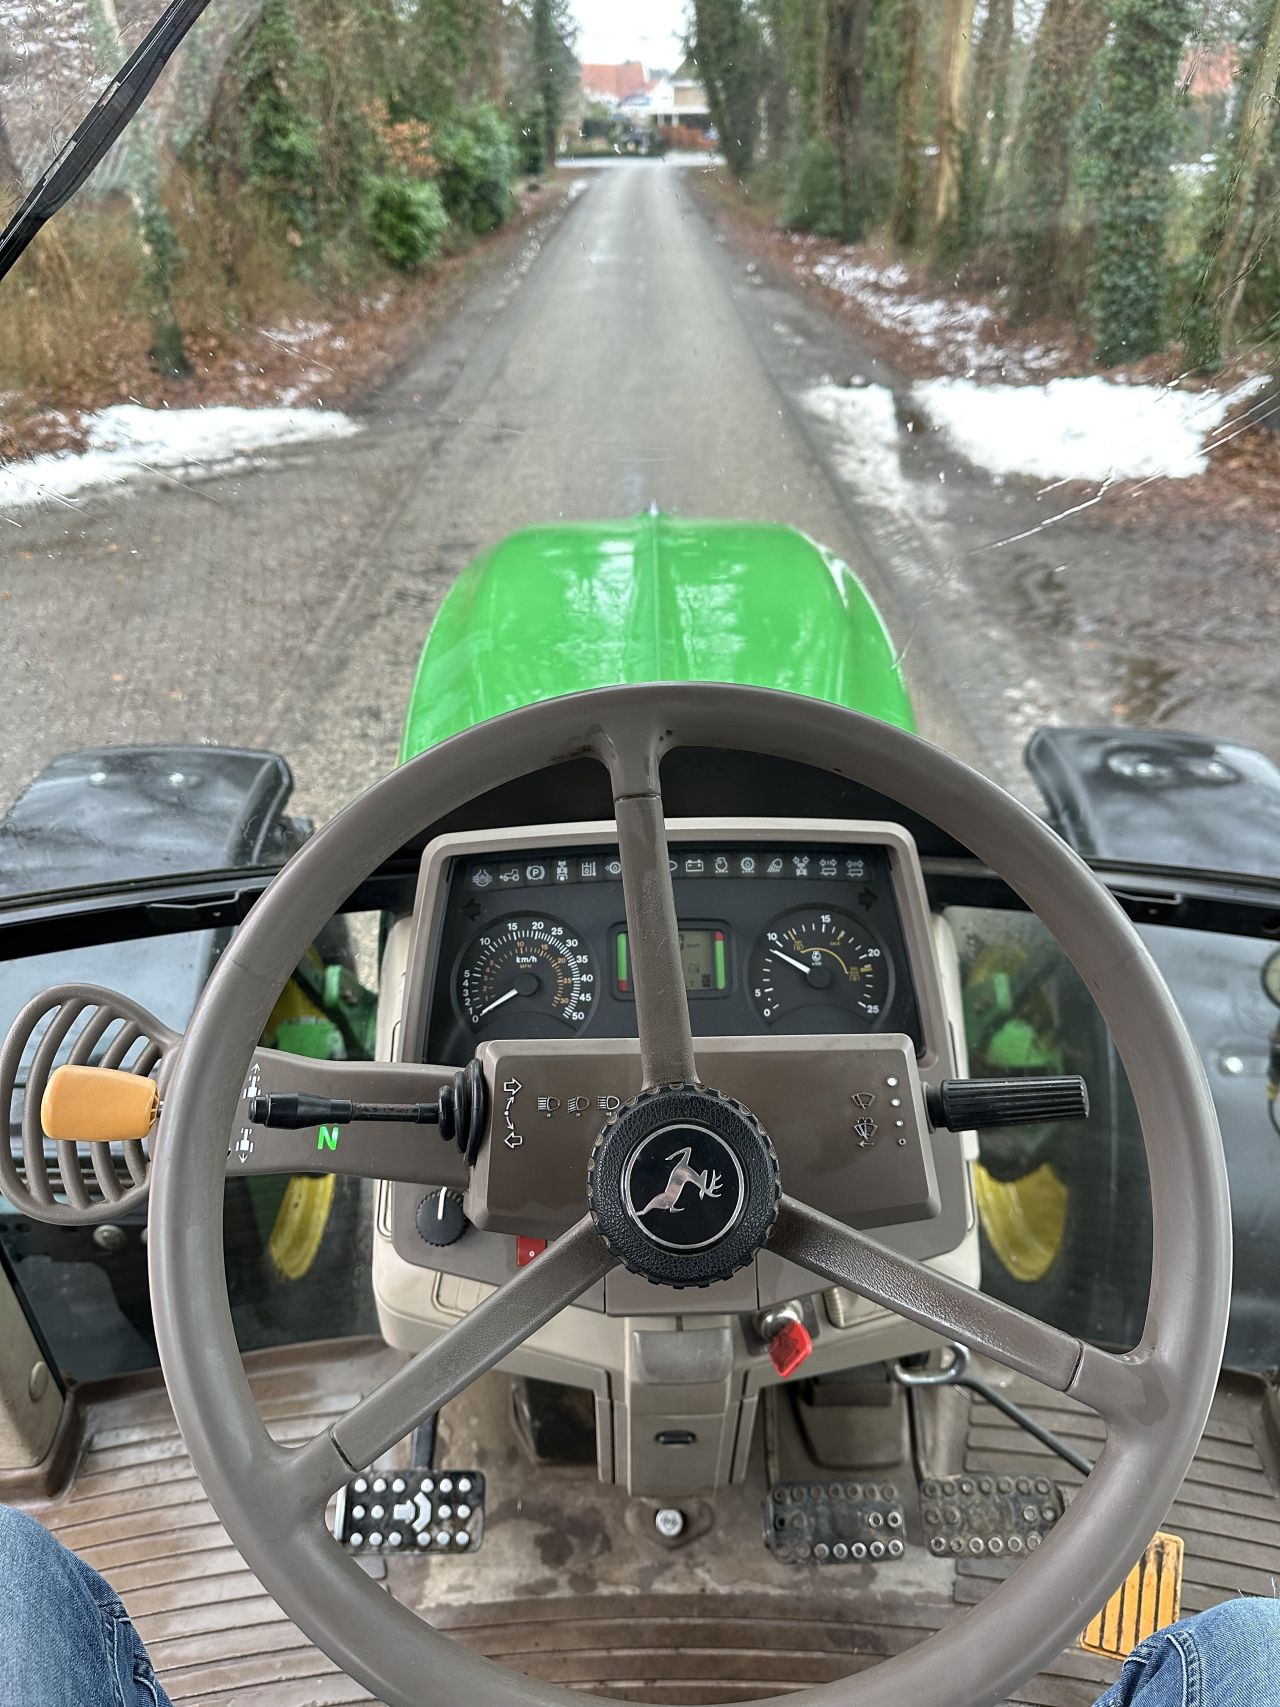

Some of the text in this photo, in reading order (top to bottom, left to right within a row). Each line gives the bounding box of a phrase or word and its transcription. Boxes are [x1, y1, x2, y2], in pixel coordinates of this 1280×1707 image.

[820, 914, 831, 923] 15
[507, 922, 518, 930] 15
[532, 922, 544, 930] 20
[551, 927, 563, 935] 25
[766, 933, 778, 941] 10
[480, 937, 491, 946] 10
[566, 939, 578, 947] 30
[868, 949, 881, 957] 20
[576, 955, 588, 964] 35
[581, 974, 593, 982] 40
[463, 989, 469, 997] 3
[579, 993, 592, 1001] 45
[755, 989, 761, 997] 5
[464, 998, 471, 1006] 2
[764, 1008, 771, 1017] 0
[867, 1005, 879, 1014] 25
[572, 1012, 584, 1020] 50
[318, 1126, 339, 1150] N
